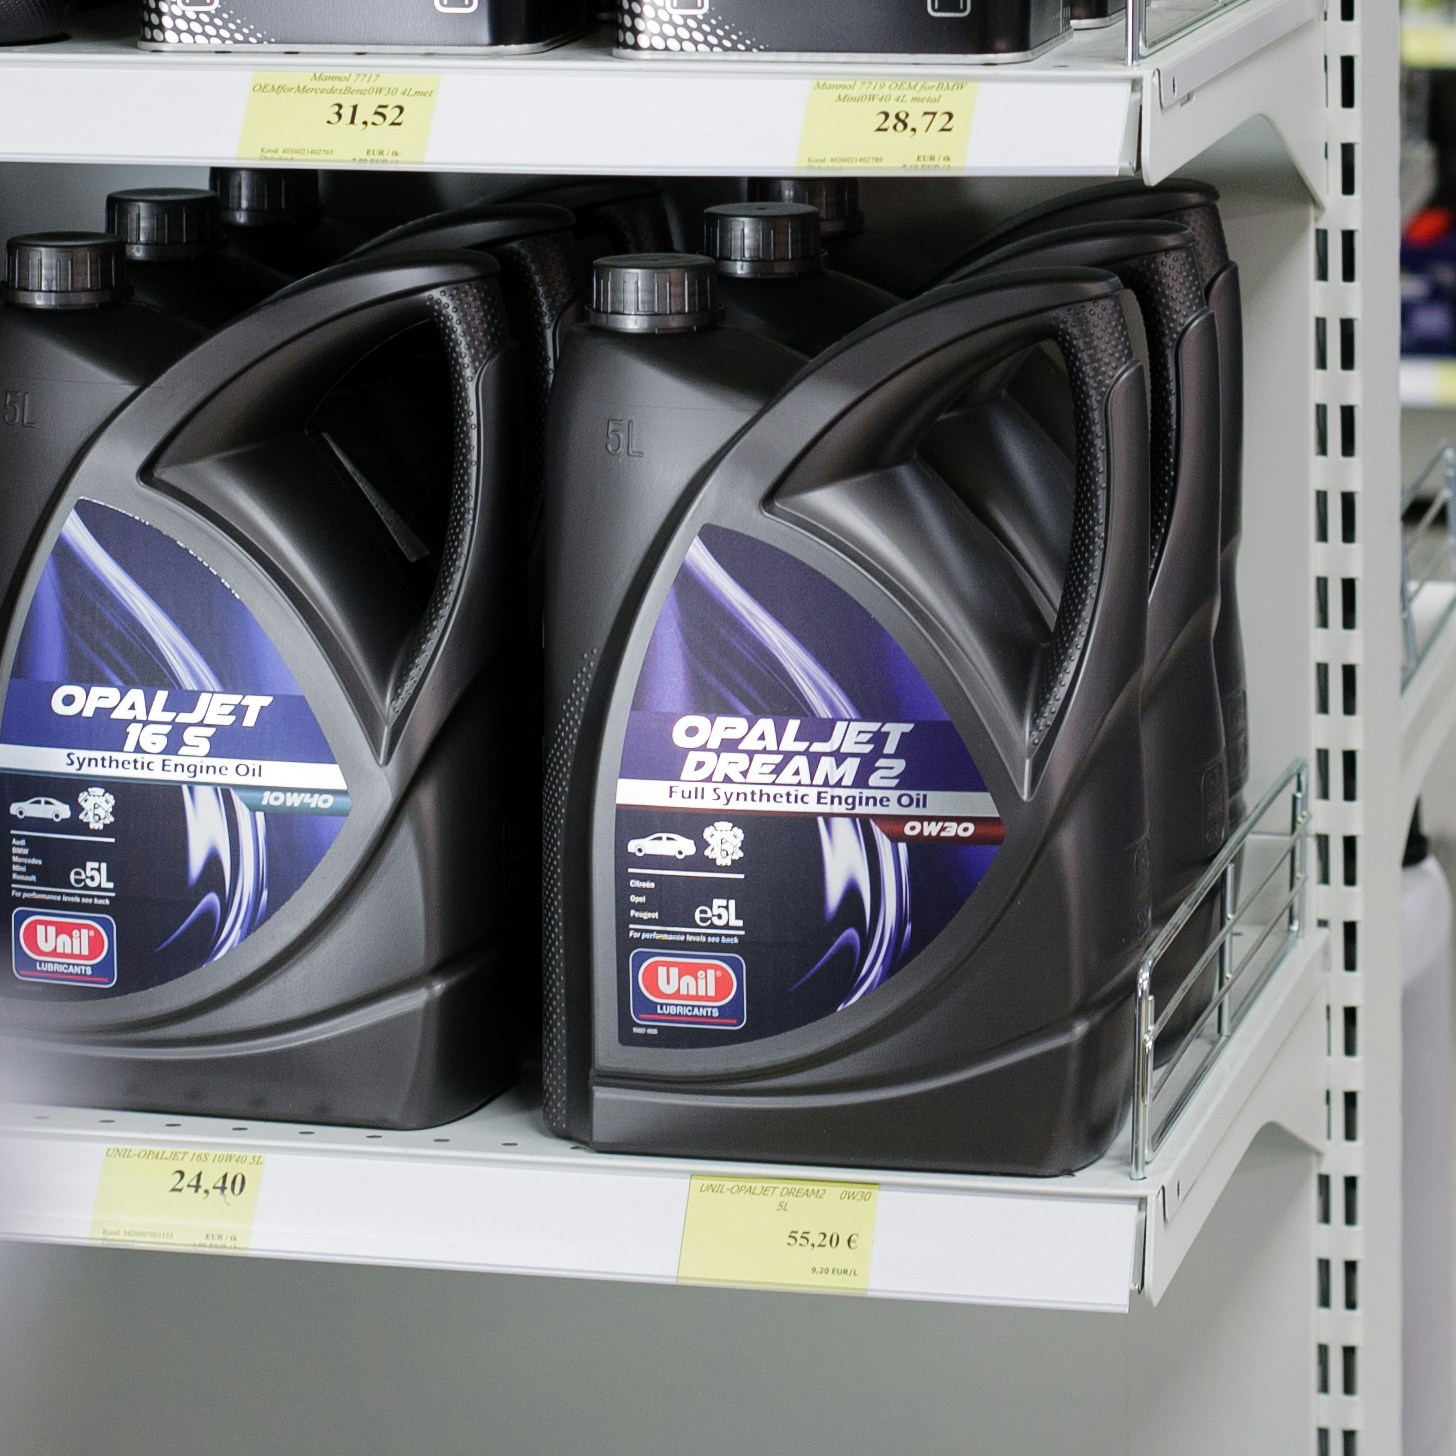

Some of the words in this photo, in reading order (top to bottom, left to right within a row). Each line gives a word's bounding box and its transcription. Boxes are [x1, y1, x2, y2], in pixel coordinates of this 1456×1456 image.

[310, 72, 352, 83] Mannol
[354, 74, 380, 83] 7717
[326, 102, 405, 131] 31,52
[874, 110, 954, 138] 28,72
[605, 418, 644, 457] 5L
[50, 684, 274, 727] OPALJET
[123, 722, 173, 754] 16
[177, 726, 216, 757] S
[671, 714, 915, 755] OPALJET
[66, 752, 155, 772] Synthetic
[161, 758, 229, 779] Engine
[235, 763, 262, 778] Oil
[680, 750, 862, 787] DREAM
[868, 758, 907, 788] 2
[261, 790, 334, 809] 10W40
[668, 785, 705, 801] Full
[712, 787, 810, 806] Synthetic
[816, 790, 891, 811] Engine
[897, 793, 928, 809] Oil
[903, 820, 975, 838] 0W30
[36, 924, 89, 956] Unil
[629, 930, 641, 938] For
[641, 932, 685, 942] performance
[686, 934, 706, 943] levels
[721, 935, 739, 944] back
[36, 962, 92, 976] LUBRICANTS
[657, 966, 715, 997] Unil
[657, 1004, 719, 1017] LUBRICANTS
[105, 1147, 189, 1162] UNIL-OPALJET
[189, 1152, 210, 1163] 16S
[211, 1154, 248, 1165] 10W40
[249, 1155, 264, 1165] 5L
[169, 1169, 245, 1200] 24,40
[699, 1183, 779, 1197] UNIL-OPALJET
[779, 1186, 827, 1199] DREAM2
[839, 1190, 872, 1202] 0W30
[776, 1201, 789, 1212] 5L
[786, 1230, 840, 1254] 55,20
[847, 1232, 860, 1250] €
[832, 1267, 858, 1277] EUR/L
